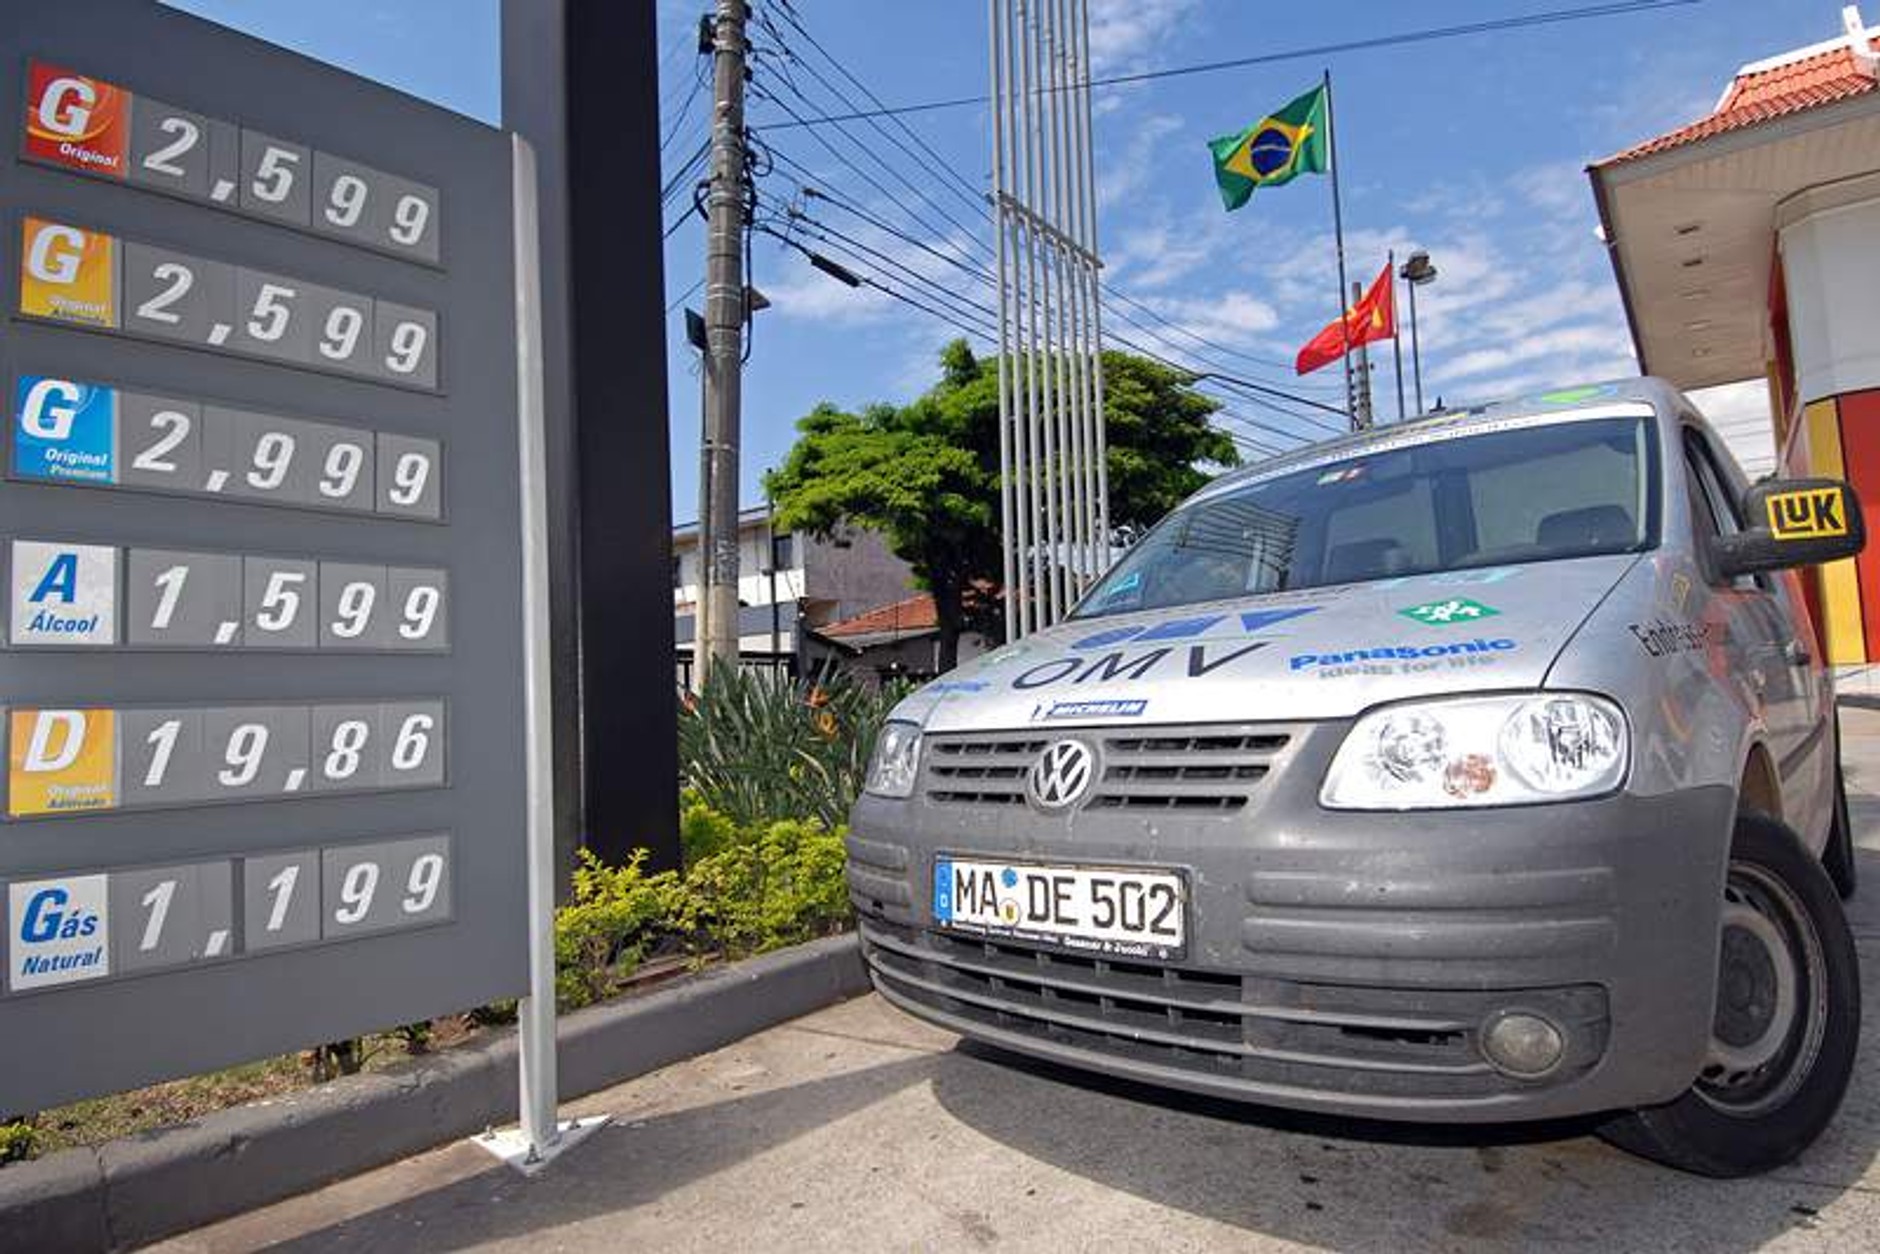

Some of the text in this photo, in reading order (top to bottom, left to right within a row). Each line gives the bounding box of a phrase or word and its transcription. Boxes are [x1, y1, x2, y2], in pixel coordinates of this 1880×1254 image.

[39, 77, 96, 136] G
[60, 142, 118, 167] Original
[29, 224, 86, 285] G
[20, 379, 80, 440] G
[45, 447, 108, 467] Original
[29, 553, 78, 604] A
[29, 608, 98, 634] Álcool
[1011, 640, 1272, 690] OMV
[1290, 639, 1516, 670] Panasonic
[24, 709, 87, 773] D
[144, 713, 434, 793] 19,86
[20, 888, 98, 944] Gás
[955, 867, 1178, 937] MA DE 502
[21, 948, 101, 977] Natural
